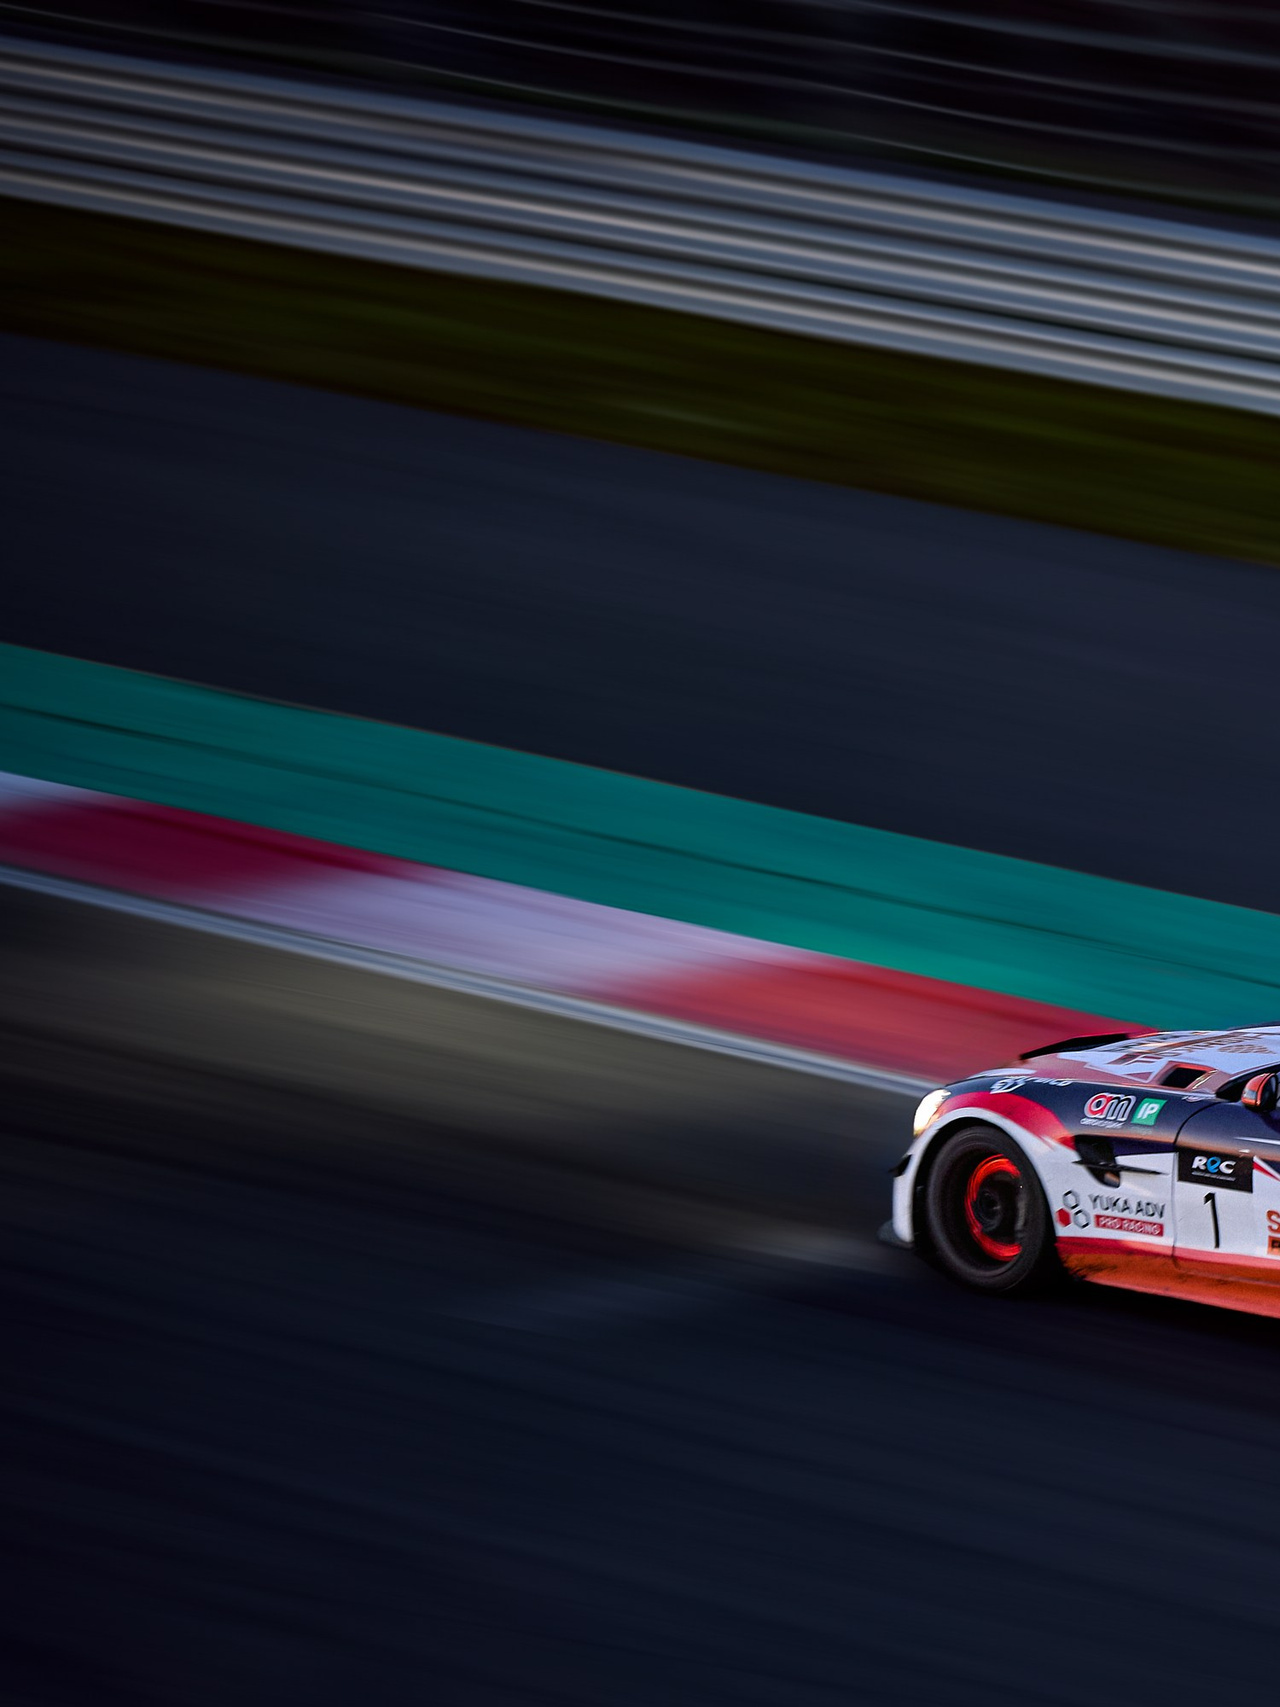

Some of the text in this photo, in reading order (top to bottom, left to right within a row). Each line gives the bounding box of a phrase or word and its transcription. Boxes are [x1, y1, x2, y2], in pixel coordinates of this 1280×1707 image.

[1089, 1194, 1166, 1219] YUKA ADV
[1100, 1216, 1161, 1235] PRO RACING
[1204, 1193, 1220, 1248] 1
